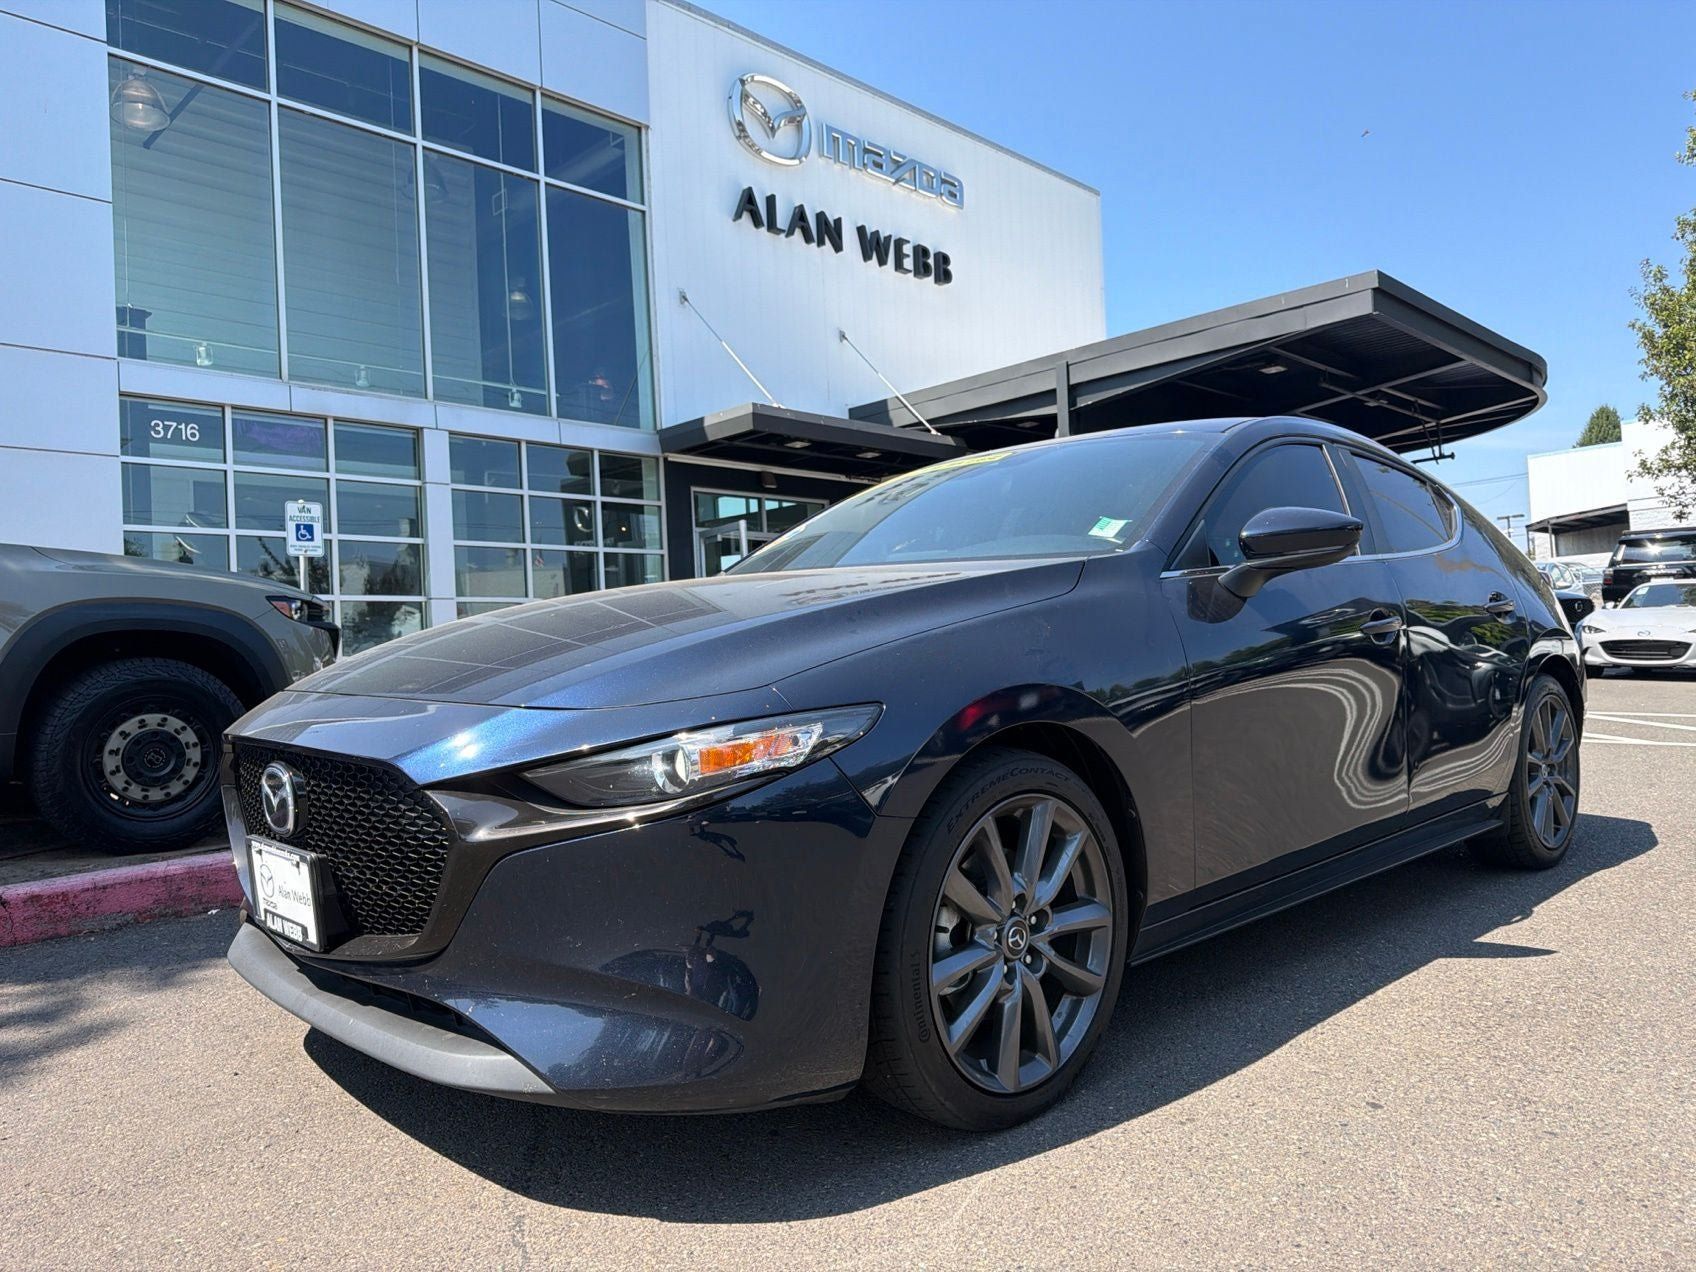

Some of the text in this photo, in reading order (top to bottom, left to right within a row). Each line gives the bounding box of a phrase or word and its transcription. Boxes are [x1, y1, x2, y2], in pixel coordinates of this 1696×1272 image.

[732, 186, 953, 286] ALAN WEBB
[150, 419, 199, 441] 3716
[297, 506, 312, 515] VAN
[288, 514, 321, 523] ACCESSIBLE
